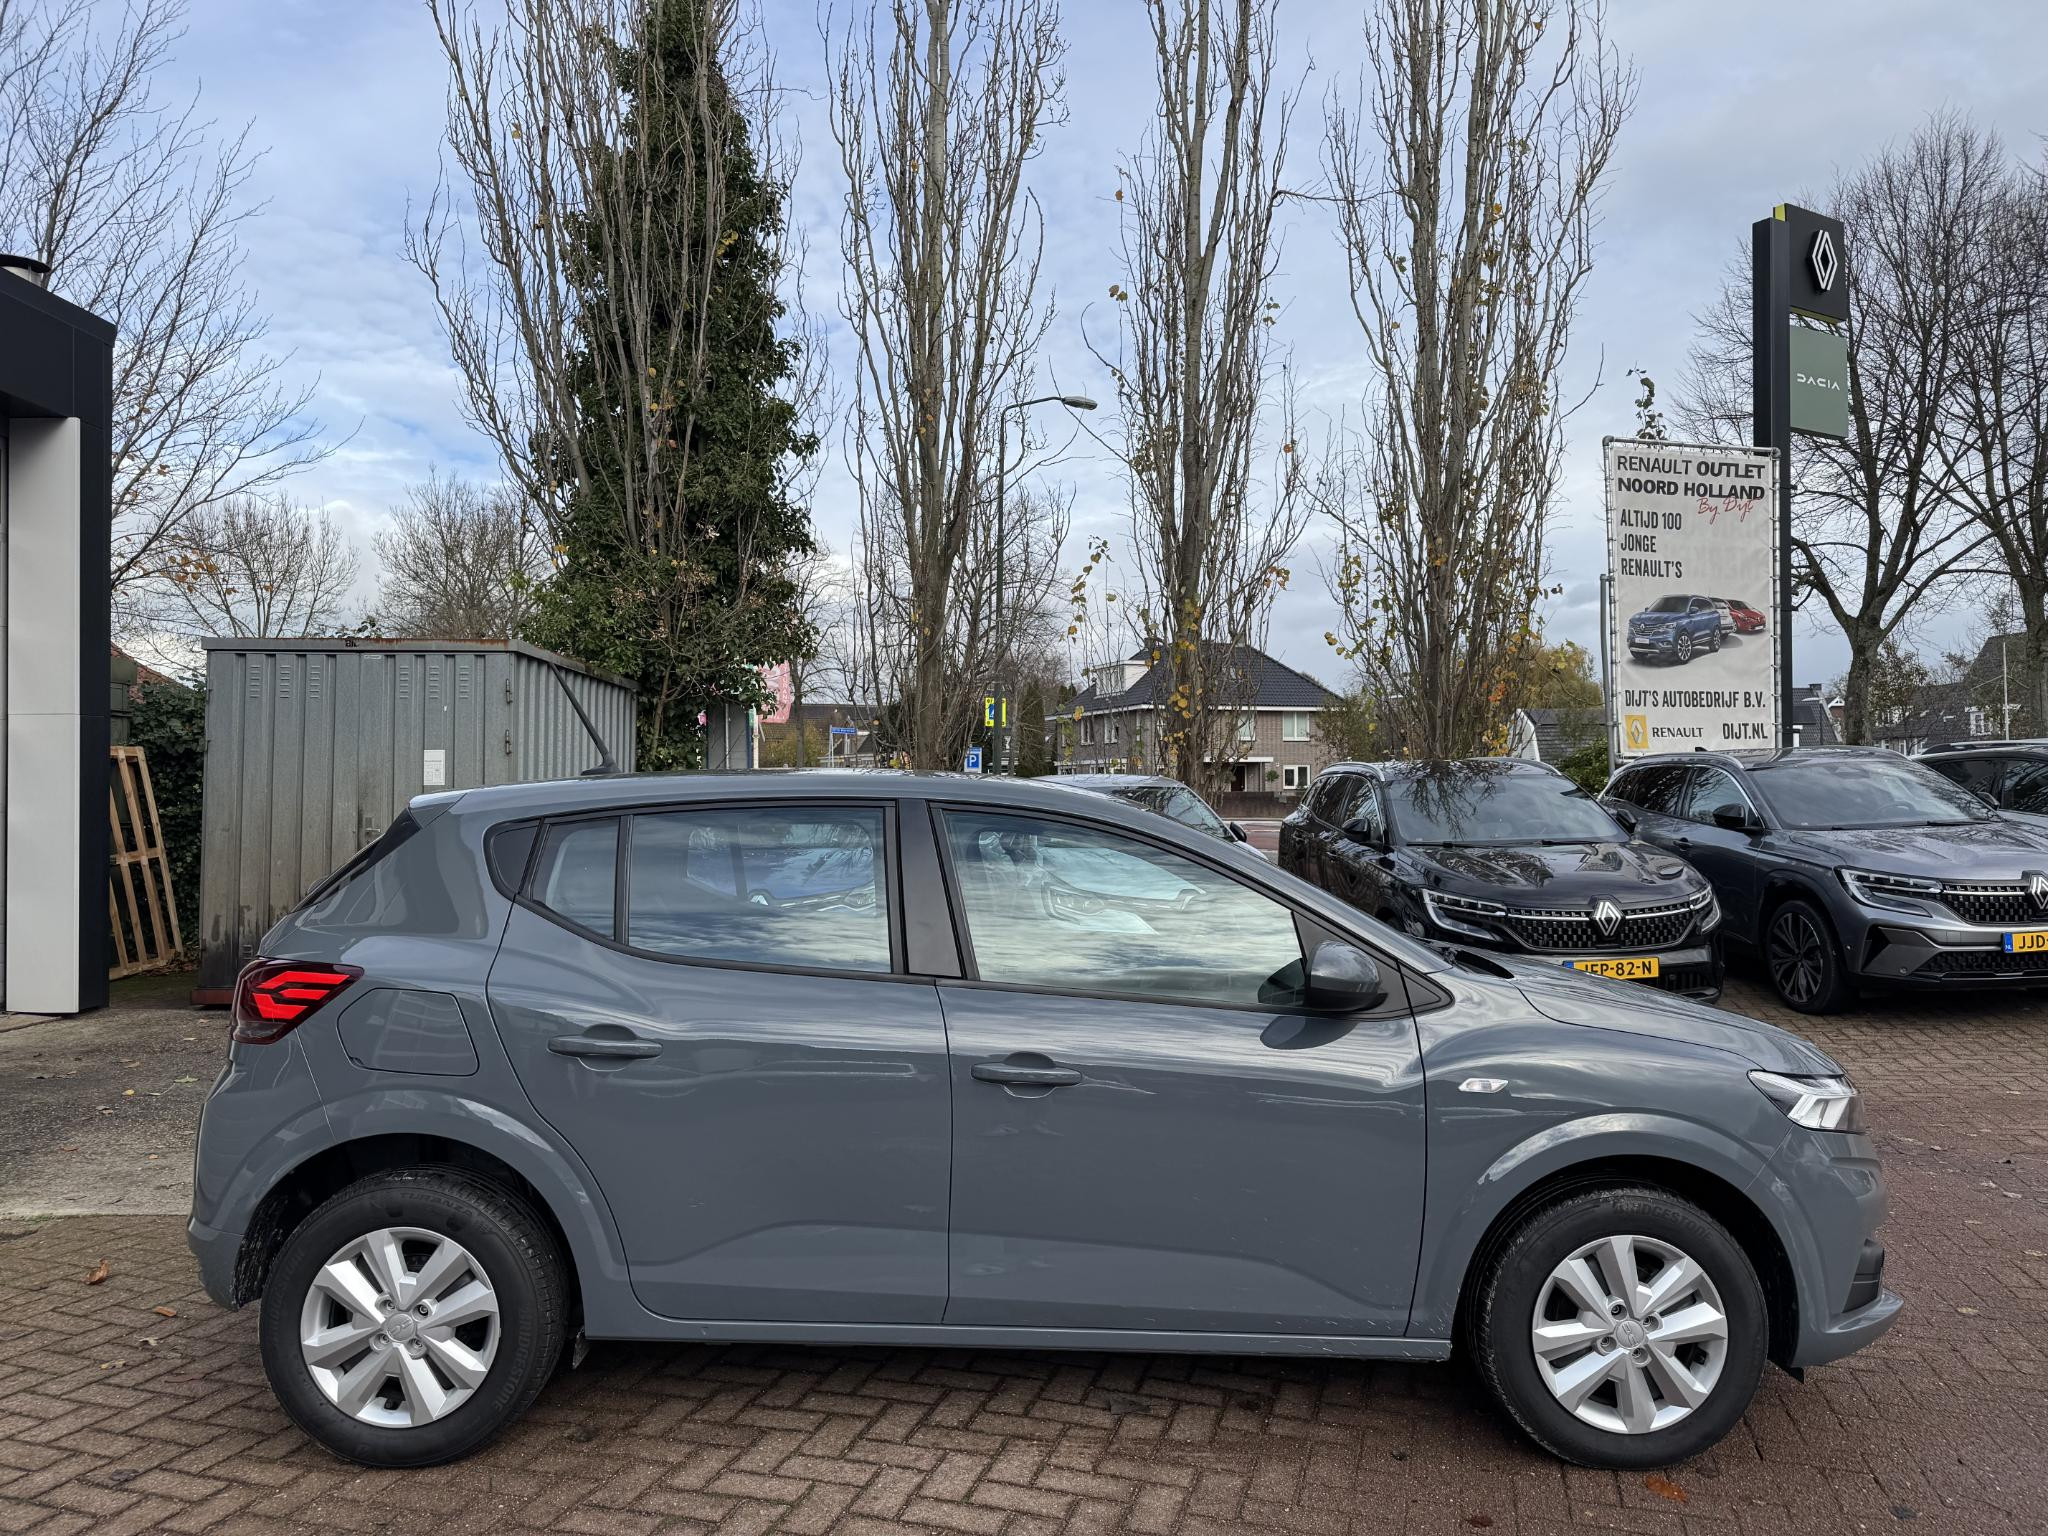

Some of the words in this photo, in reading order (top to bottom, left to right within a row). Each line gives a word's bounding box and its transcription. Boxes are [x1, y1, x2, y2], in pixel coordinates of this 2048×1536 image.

[1796, 373, 1840, 391] DACIA
[1617, 455, 1692, 475] RENAULT
[1696, 460, 1765, 479] OUTLET
[1617, 477, 1679, 496] NOORD
[1684, 481, 1765, 500] HOLLAND
[1620, 508, 1659, 529] ALTIJD
[1662, 512, 1682, 530] 100
[1696, 498, 1719, 525] By
[1620, 533, 1657, 553] JONGE
[1621, 557, 1683, 579] RENAULT'S
[1625, 690, 1659, 708] DIJT'S
[1662, 690, 1740, 708] AUTOBEDRIJF
[1743, 691, 1766, 708] B.V.
[1651, 727, 1704, 738] RENAULT
[1722, 722, 1768, 740] DIJT.NL
